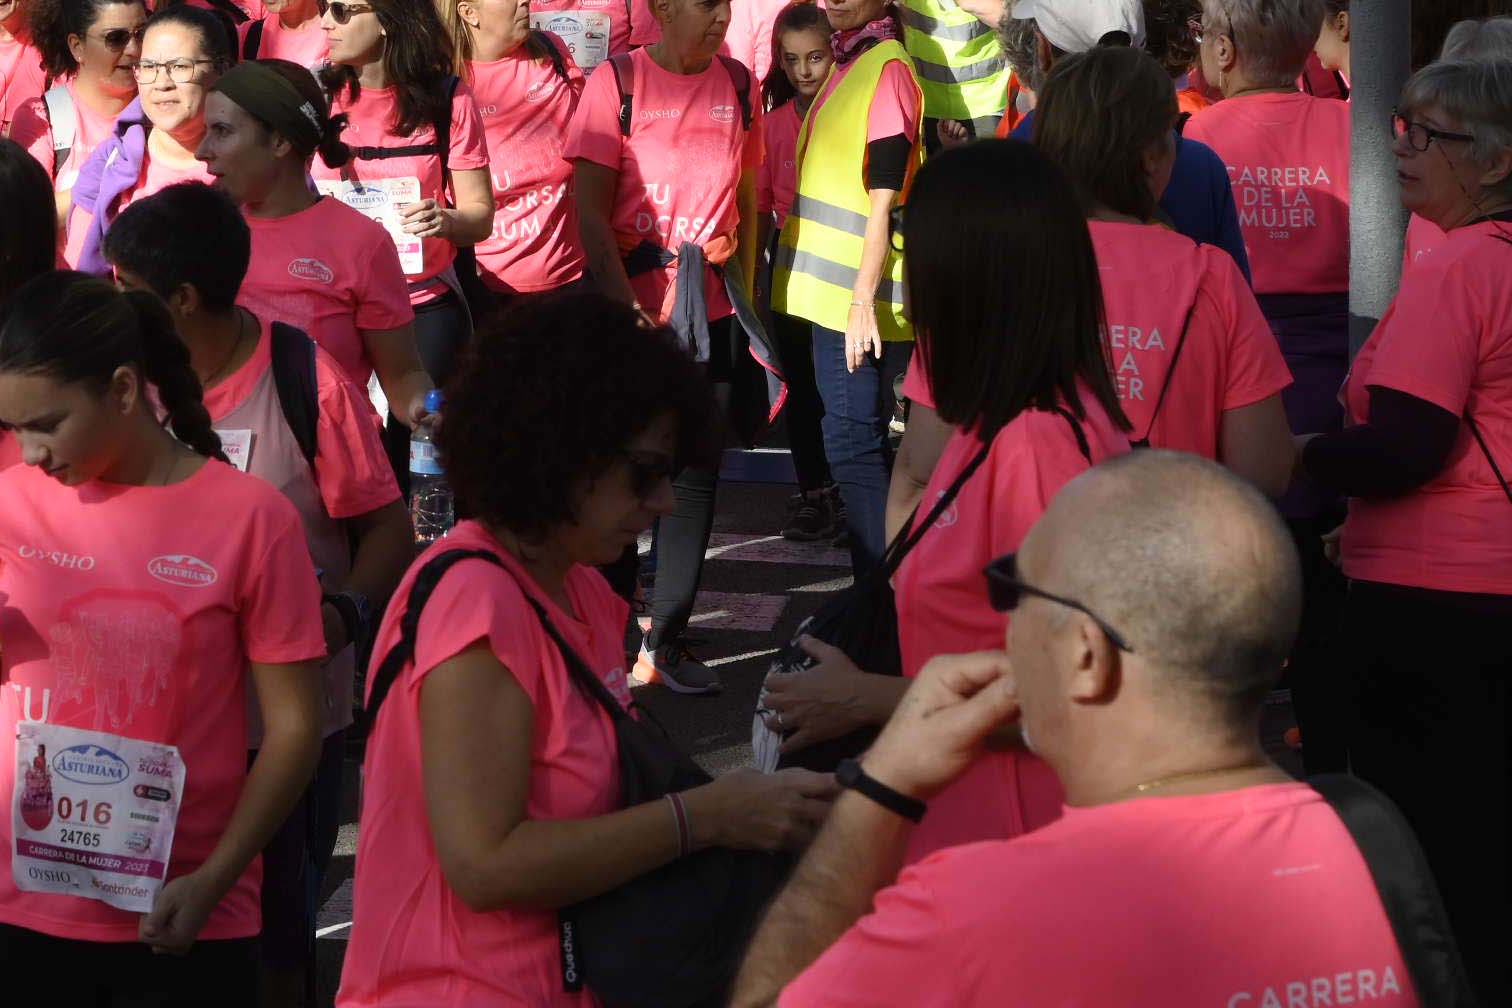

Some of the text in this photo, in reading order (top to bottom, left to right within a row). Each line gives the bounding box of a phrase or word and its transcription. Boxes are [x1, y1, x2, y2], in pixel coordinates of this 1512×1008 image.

[640, 109, 680, 120] OYSHO
[1243, 188, 1311, 207] DE LA
[1238, 208, 1317, 228] MUJER
[154, 562, 212, 583] ASTURIANA
[59, 755, 123, 779] ASTURIANA
[138, 765, 173, 778] SUMA
[57, 796, 113, 825] 016
[60, 828, 101, 848] 24765
[29, 845, 150, 873] CARRERA DE LA MUJER 2023
[28, 866, 149, 898] OYSHO Santander
